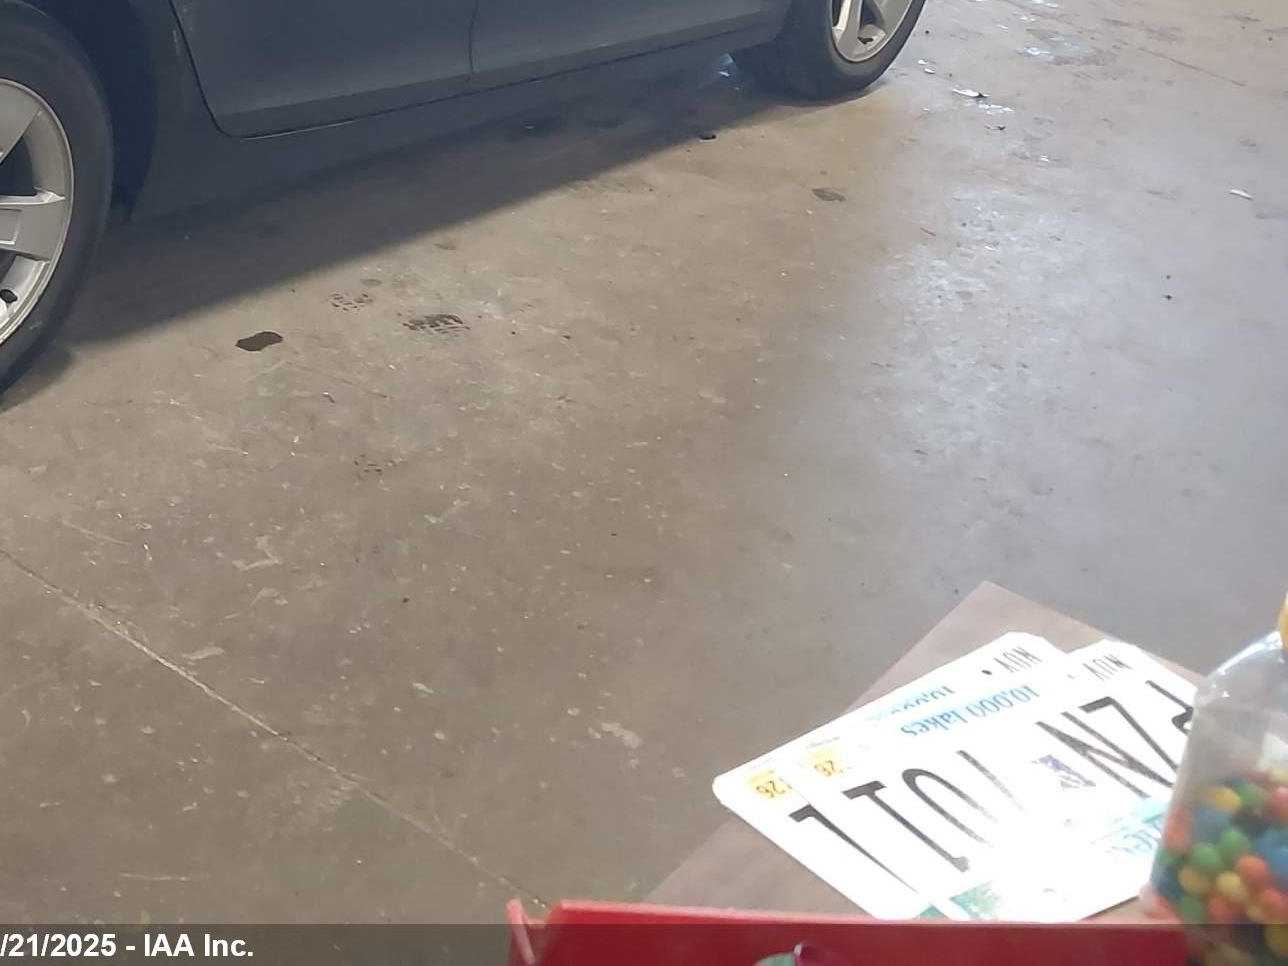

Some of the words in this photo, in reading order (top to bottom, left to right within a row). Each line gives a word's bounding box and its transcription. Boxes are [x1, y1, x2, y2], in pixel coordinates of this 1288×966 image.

[964, 683, 1041, 719] 10,000
[899, 709, 968, 738] lakes
[756, 779, 786, 799] 26
